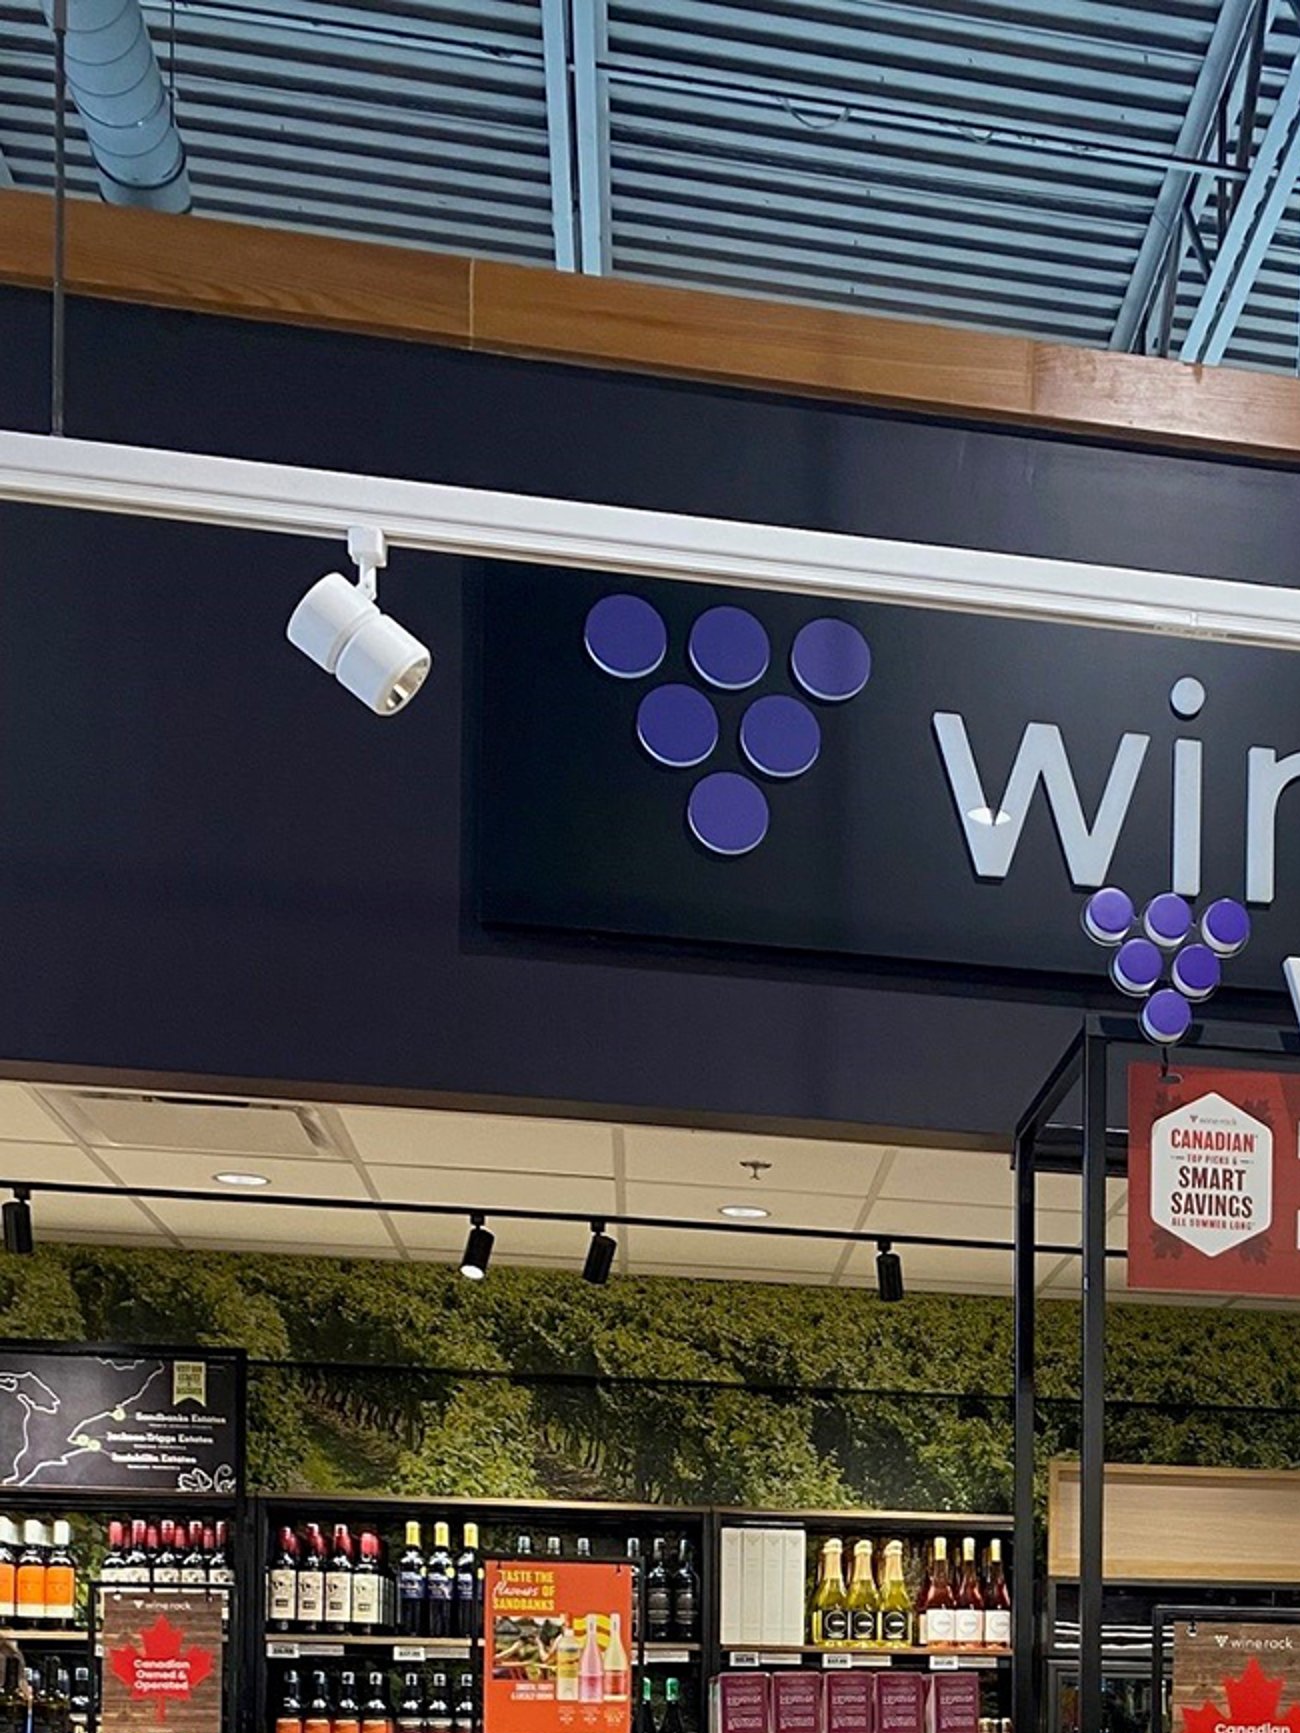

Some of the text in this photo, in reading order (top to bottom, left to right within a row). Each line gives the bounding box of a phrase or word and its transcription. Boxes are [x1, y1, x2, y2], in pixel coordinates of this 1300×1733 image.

[1178, 1165, 1247, 1191] SMART
[1171, 1192, 1254, 1218] SAVINGS
[501, 1570, 555, 1583] TASTE THE
[541, 1585, 556, 1596] OF
[493, 1598, 555, 1610] SANDBANKS
[1231, 1636, 1263, 1649] wine
[133, 1659, 191, 1669] Canadian
[136, 1670, 176, 1679] Owned
[134, 1680, 189, 1692] Operated
